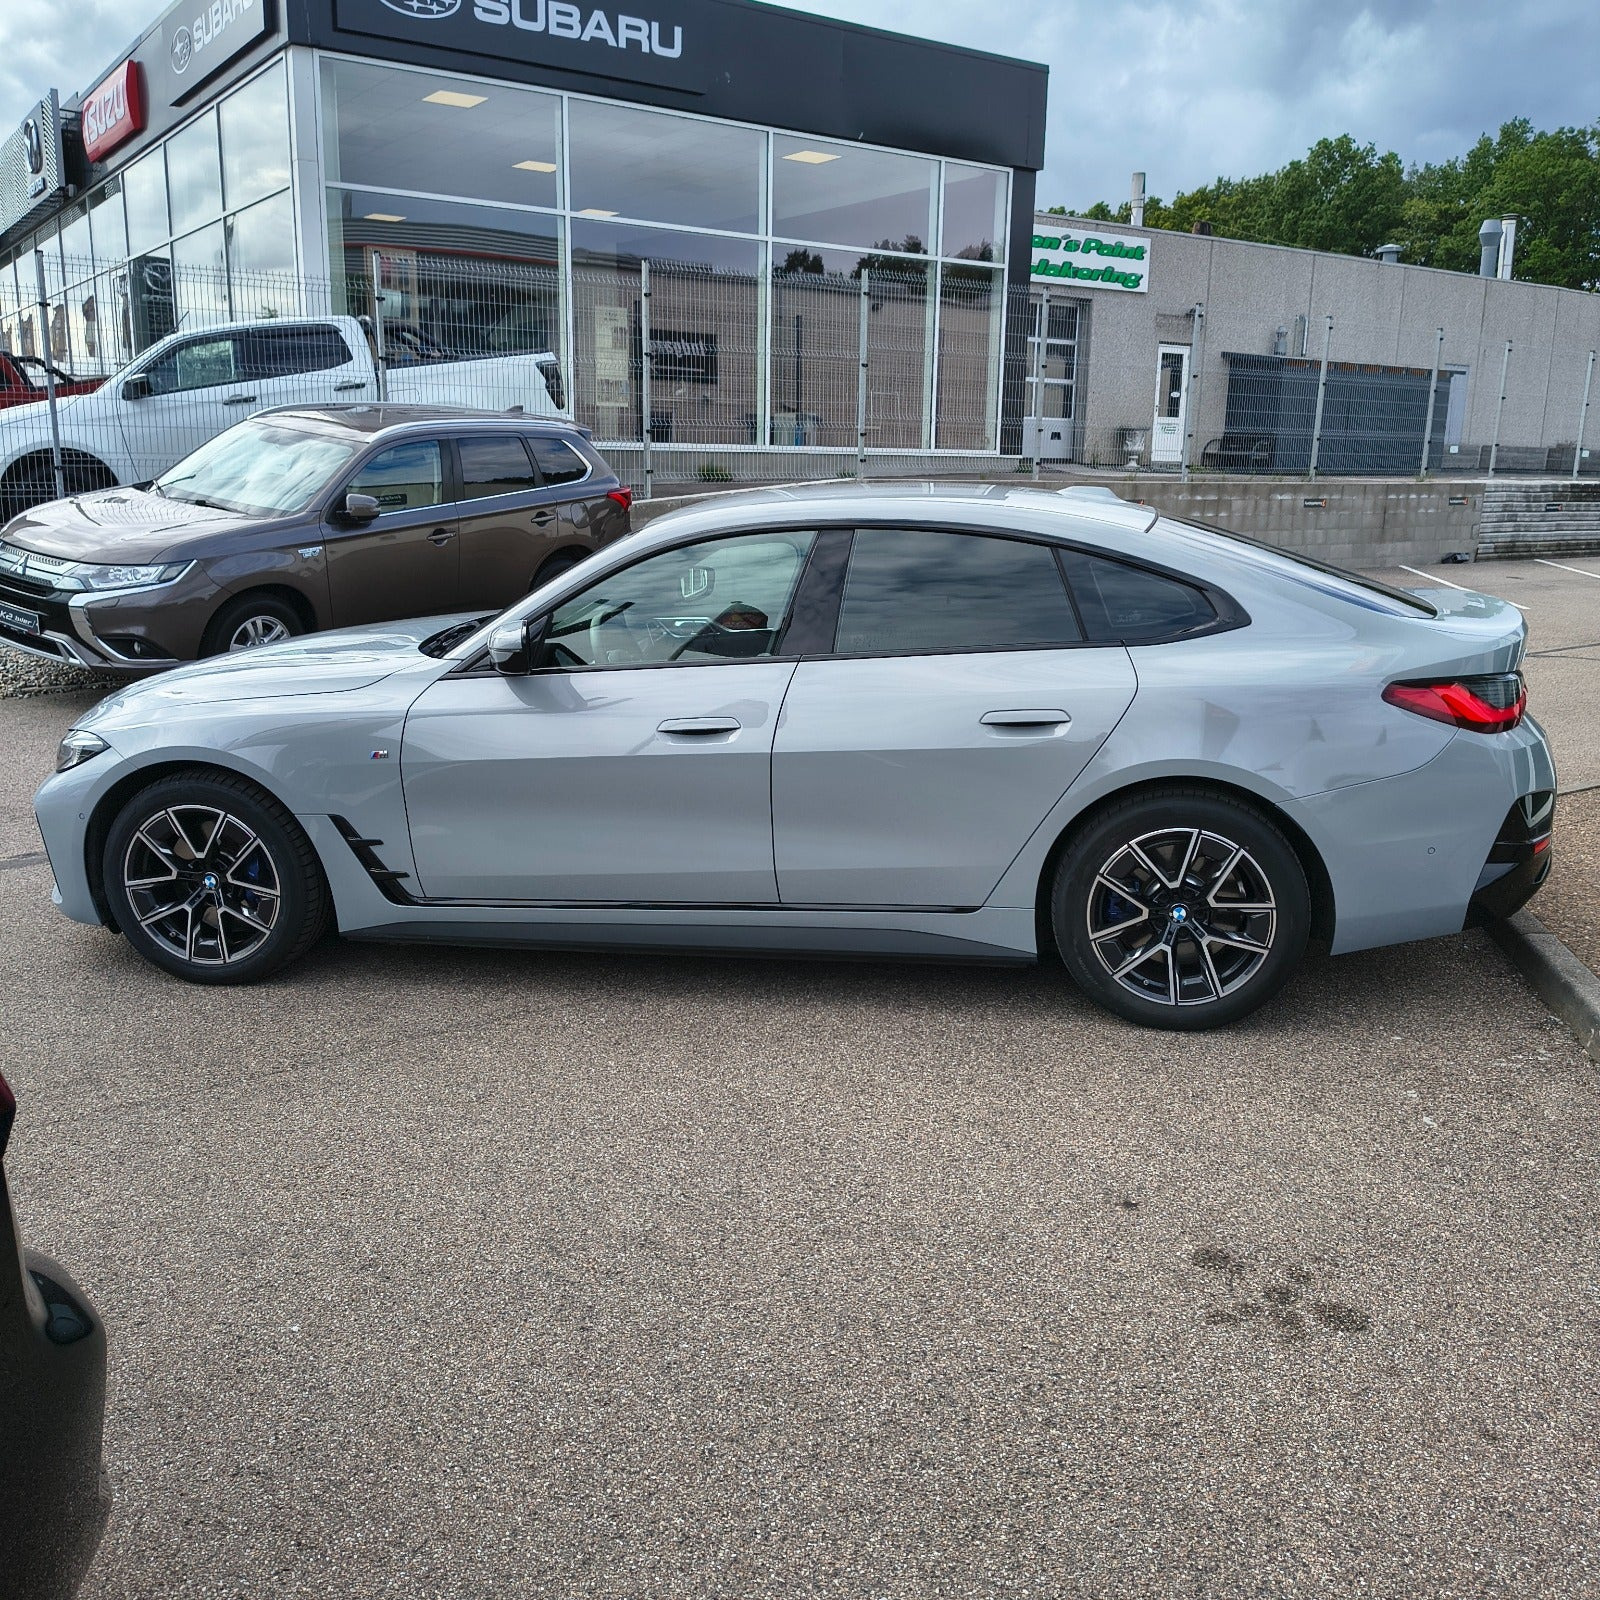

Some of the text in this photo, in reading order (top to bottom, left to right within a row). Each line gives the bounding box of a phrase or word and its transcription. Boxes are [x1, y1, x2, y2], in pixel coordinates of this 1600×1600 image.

[473, 0, 682, 59] SUBARU
[84, 79, 125, 146] ISUZU
[1081, 238, 1147, 260] Paint
